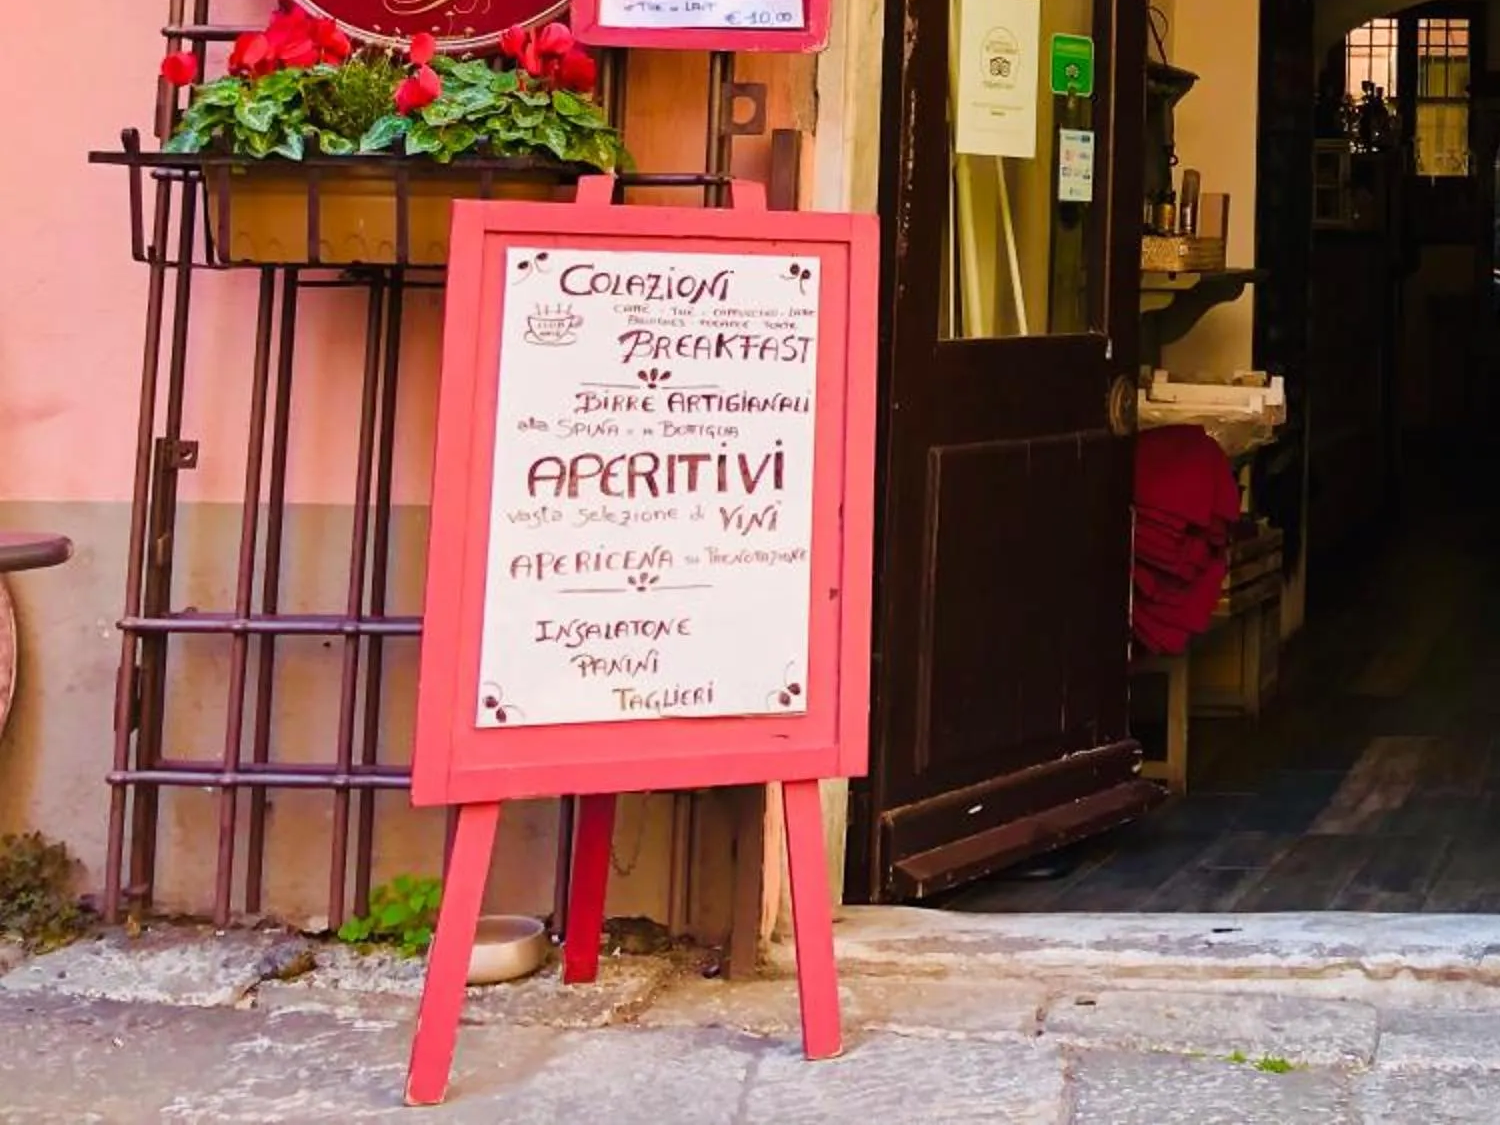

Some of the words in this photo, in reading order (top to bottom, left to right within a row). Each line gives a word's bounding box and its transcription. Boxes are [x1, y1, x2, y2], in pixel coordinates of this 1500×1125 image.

[559, 263, 736, 304] COLAZIONI
[617, 329, 814, 364] BREAKFAST
[574, 390, 656, 414] BIRRE
[667, 389, 811, 413] ARTIGIANALI
[557, 418, 618, 438] SPINA
[527, 439, 785, 499] APERITIVI
[506, 506, 563, 529] vasta
[719, 500, 782, 536] VINI
[510, 544, 673, 581] APERICENA
[535, 618, 691, 648] INSALATONE
[569, 649, 659, 678] PANINI
[612, 681, 714, 712] TAGLIERI
